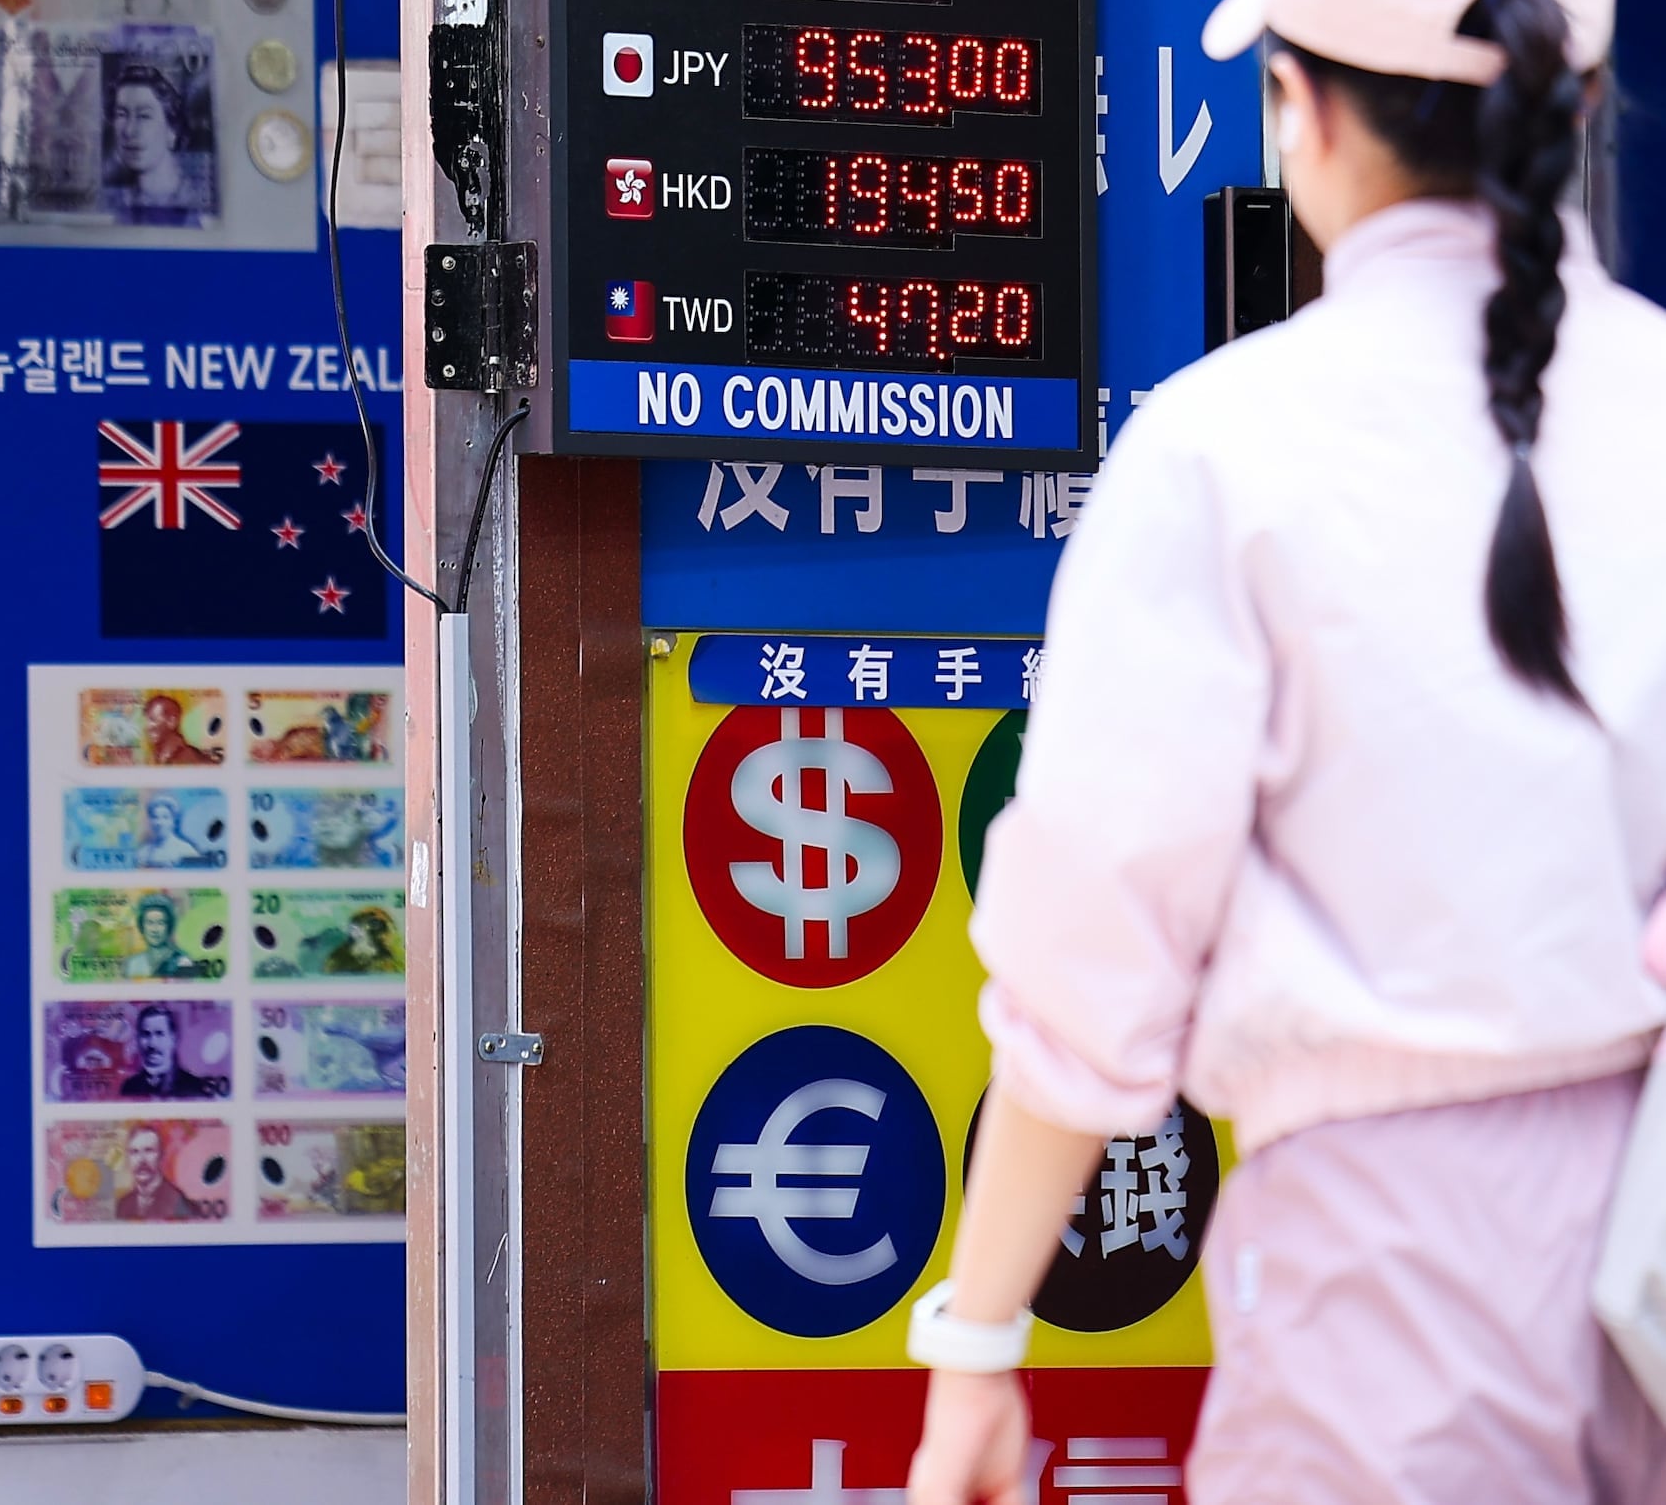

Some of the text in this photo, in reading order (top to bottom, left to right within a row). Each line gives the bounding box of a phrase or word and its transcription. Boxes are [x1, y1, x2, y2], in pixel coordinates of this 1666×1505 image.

[662, 51, 730, 89] JPY
[662, 173, 732, 211] HKD
[662, 297, 733, 334] TWD
[165, 343, 275, 391] NEW
[289, 346, 403, 392] ZEAL
[638, 371, 1014, 441] NO COMMISSION
[253, 894, 281, 915] 20
